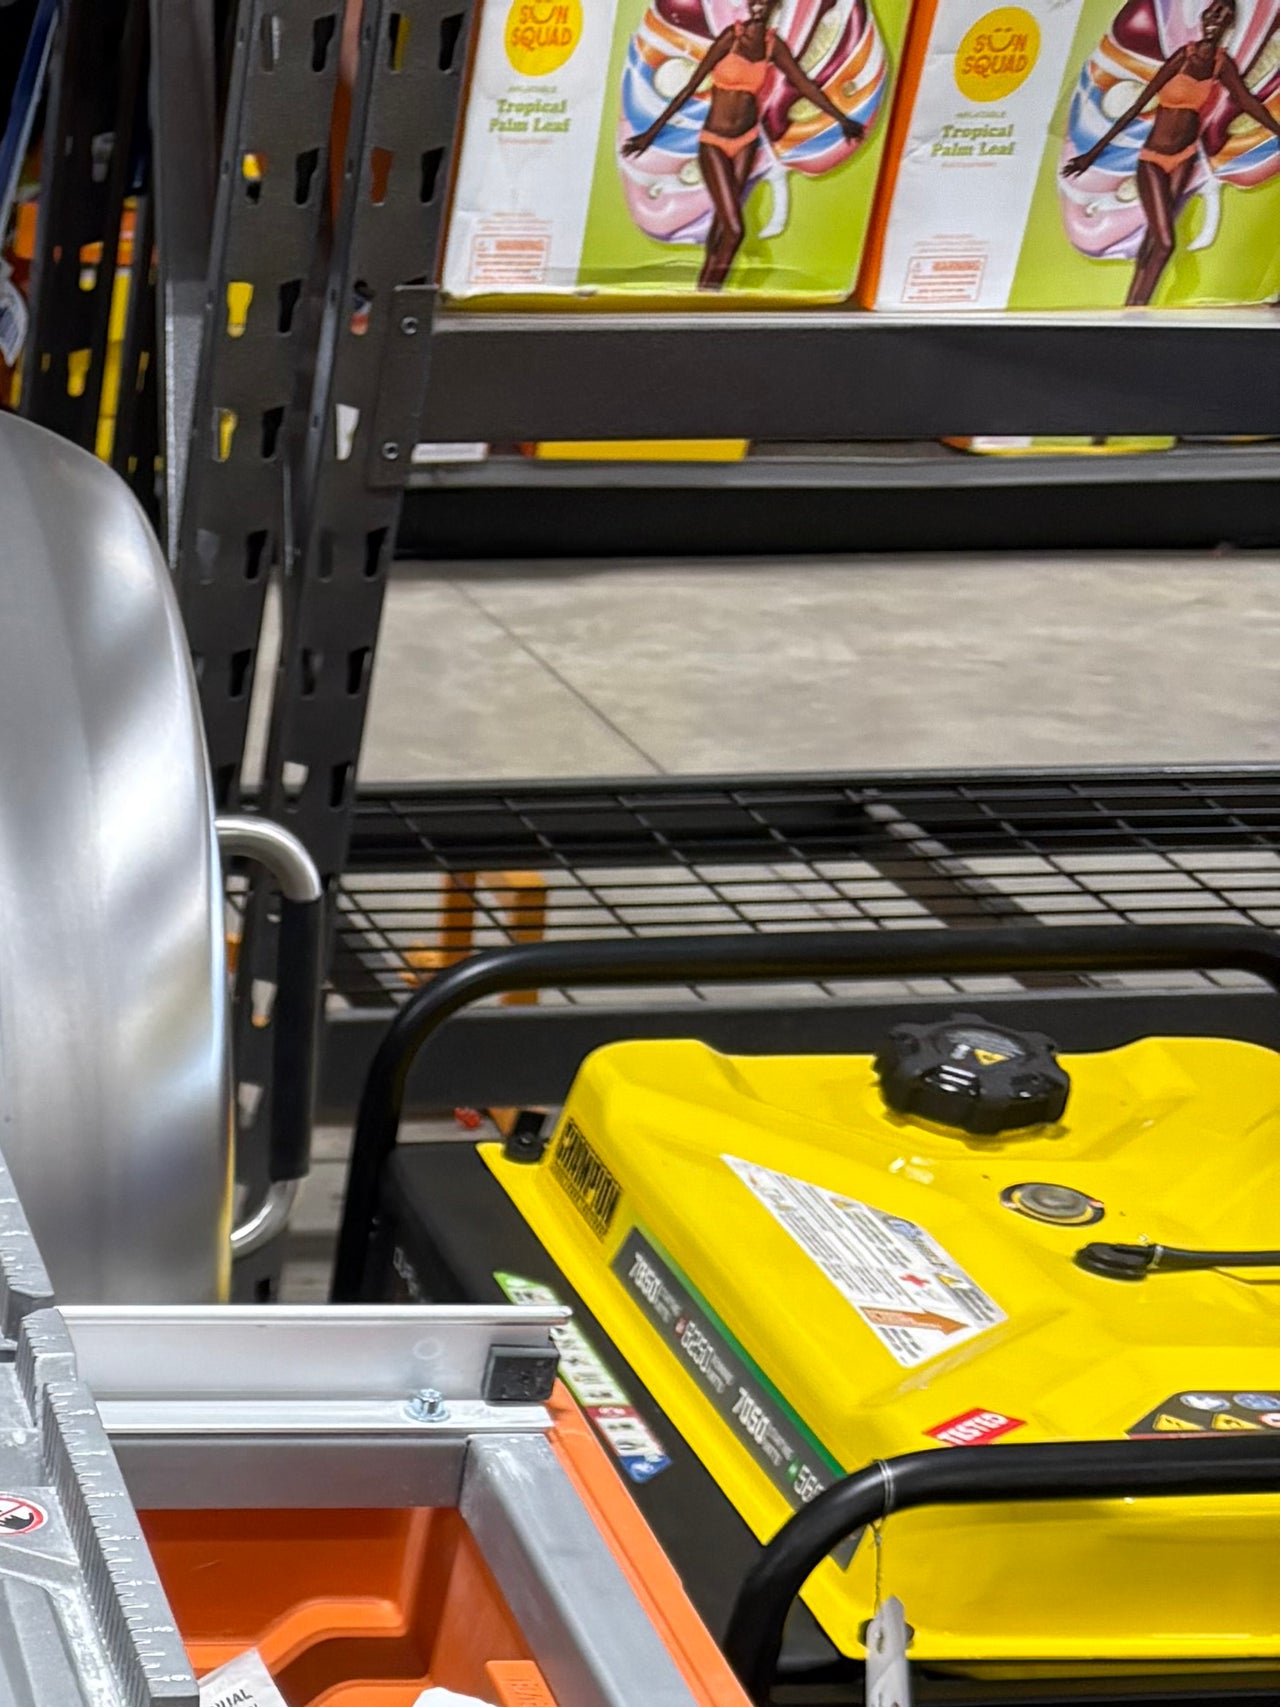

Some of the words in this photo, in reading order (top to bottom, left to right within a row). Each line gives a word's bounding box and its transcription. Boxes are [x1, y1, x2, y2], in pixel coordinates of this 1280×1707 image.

[510, 25, 573, 51] SQUAD
[961, 55, 1029, 78] SQUAD
[497, 98, 568, 115] Tropical
[488, 118, 529, 133] Palm
[533, 117, 571, 133] Leaf
[941, 123, 1015, 141] Tropical
[929, 142, 974, 158] Palm
[977, 141, 1017, 157] Leaf
[681, 1320, 715, 1373] 6250
[732, 1386, 771, 1444] 7050
[936, 1411, 1009, 1446] TESTED
